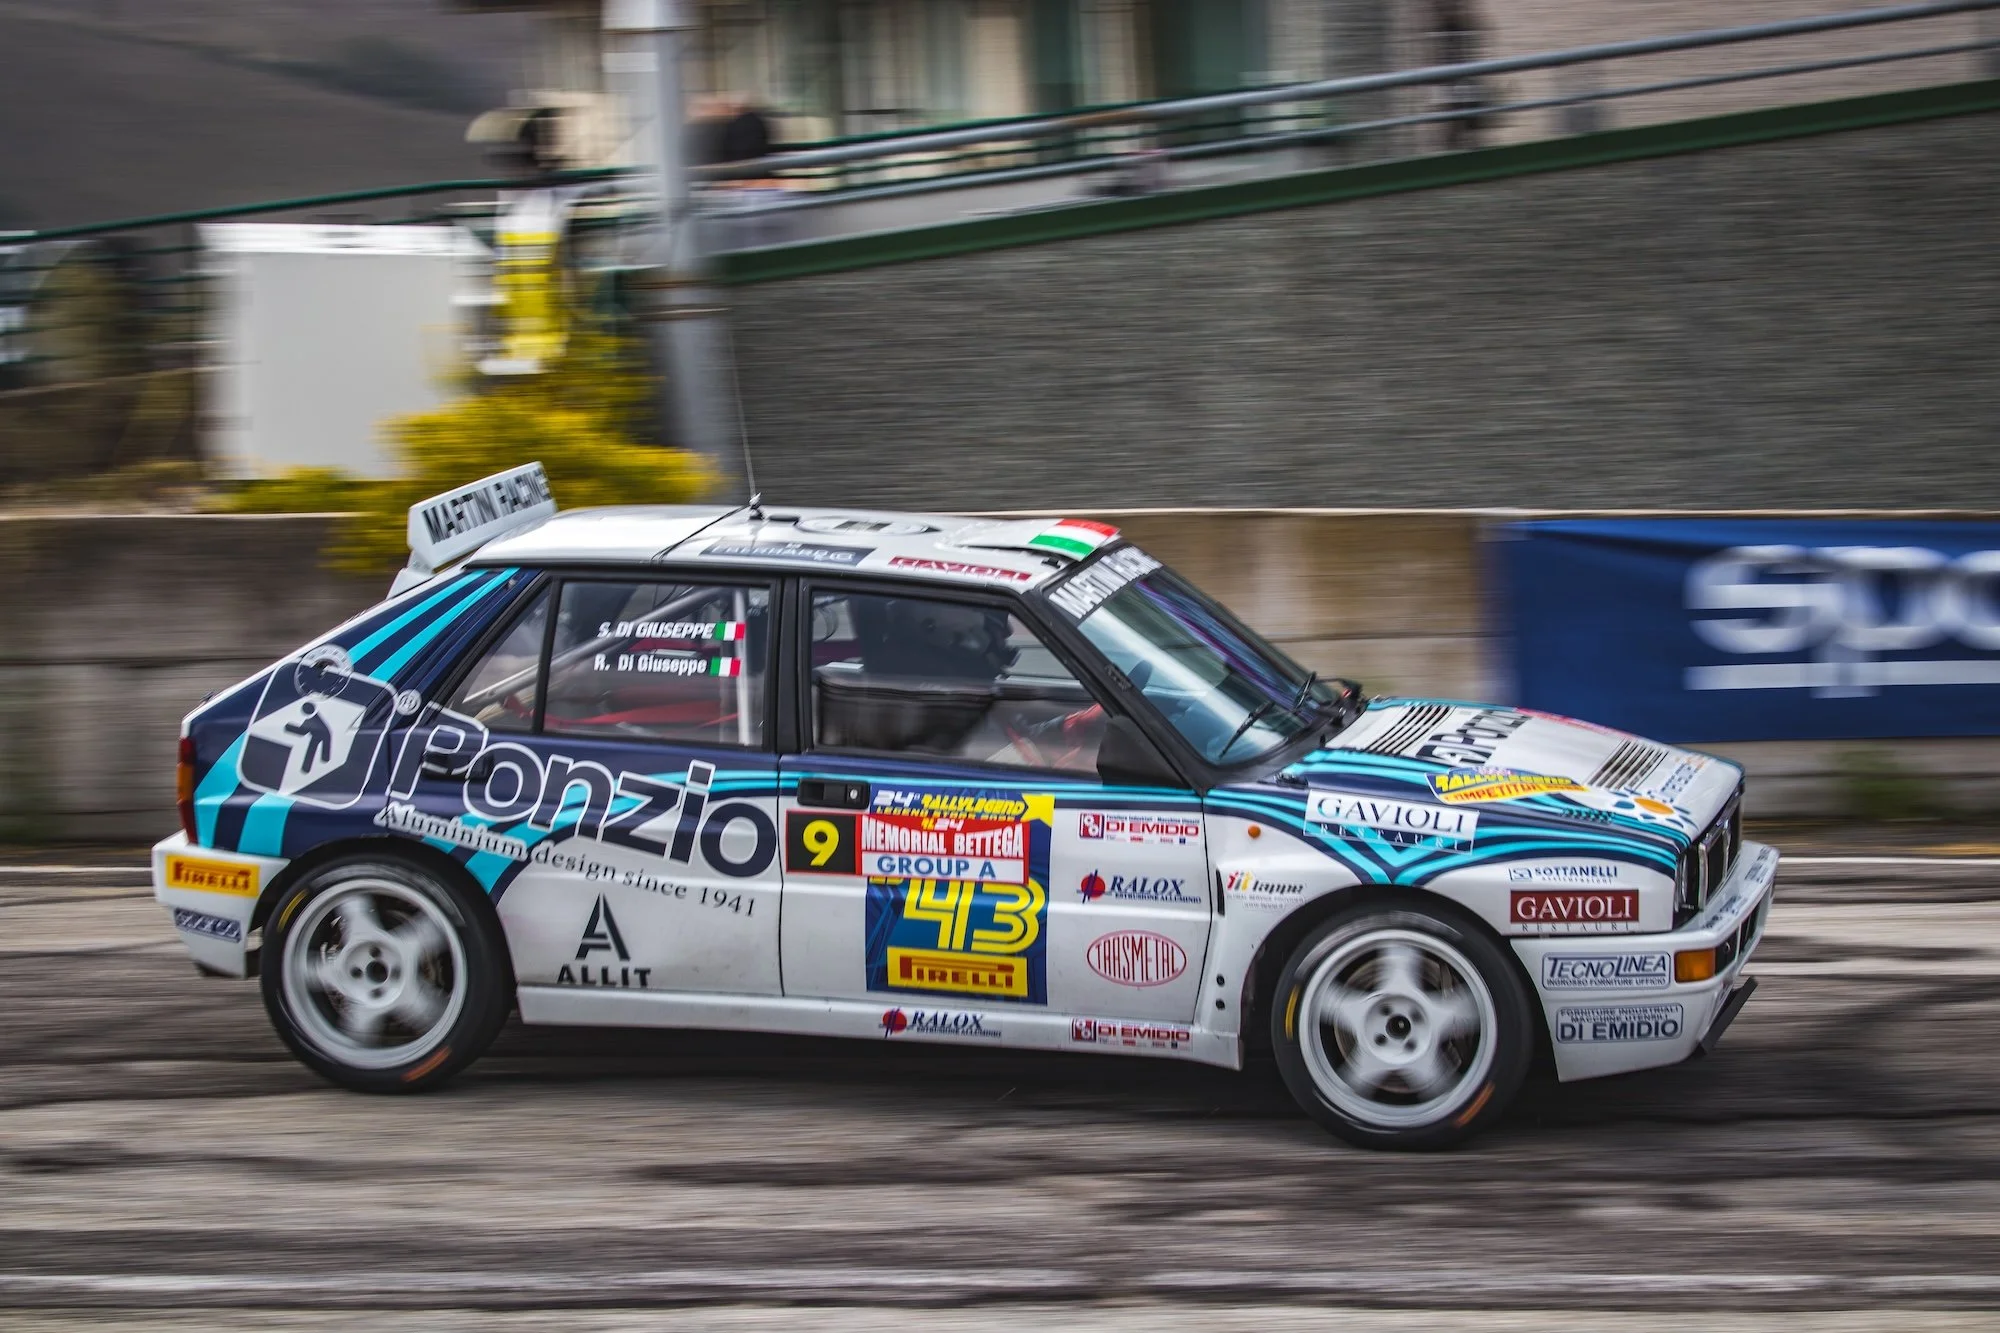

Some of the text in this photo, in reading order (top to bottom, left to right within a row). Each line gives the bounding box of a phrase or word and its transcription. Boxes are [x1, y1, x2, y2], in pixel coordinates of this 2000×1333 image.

[597, 622, 716, 639] S. DI GIUSEPPE
[594, 654, 707, 676] R. Di Giuseppe
[385, 701, 778, 879] Ponzio
[1318, 797, 1463, 833] GAVIOLI
[862, 815, 1023, 857] MEMORIAL BETTEGA
[1106, 821, 1199, 836] DI EMIDIO
[1320, 823, 1458, 851] RESTAURI
[802, 820, 840, 866] 9
[379, 803, 755, 917] Aluminium design since 1941
[877, 855, 997, 879] GROUP A
[1535, 866, 1617, 877] SOTTANELLI
[174, 861, 251, 890] PIRELLI
[1110, 875, 1184, 896] RALOX
[903, 877, 1046, 954] 43
[1517, 896, 1633, 920] GAVIOLI
[1522, 923, 1630, 932] RESTAURI
[556, 964, 651, 988] ALLIT
[900, 956, 1015, 989] PIRELLI
[1548, 955, 1666, 978] TECNOLINEA
[912, 1011, 983, 1030] RALOX
[1560, 1019, 1679, 1041] DI EMIDIO
[1098, 1025, 1116, 1036] DI
[1121, 1027, 1190, 1041] EMIDIO
